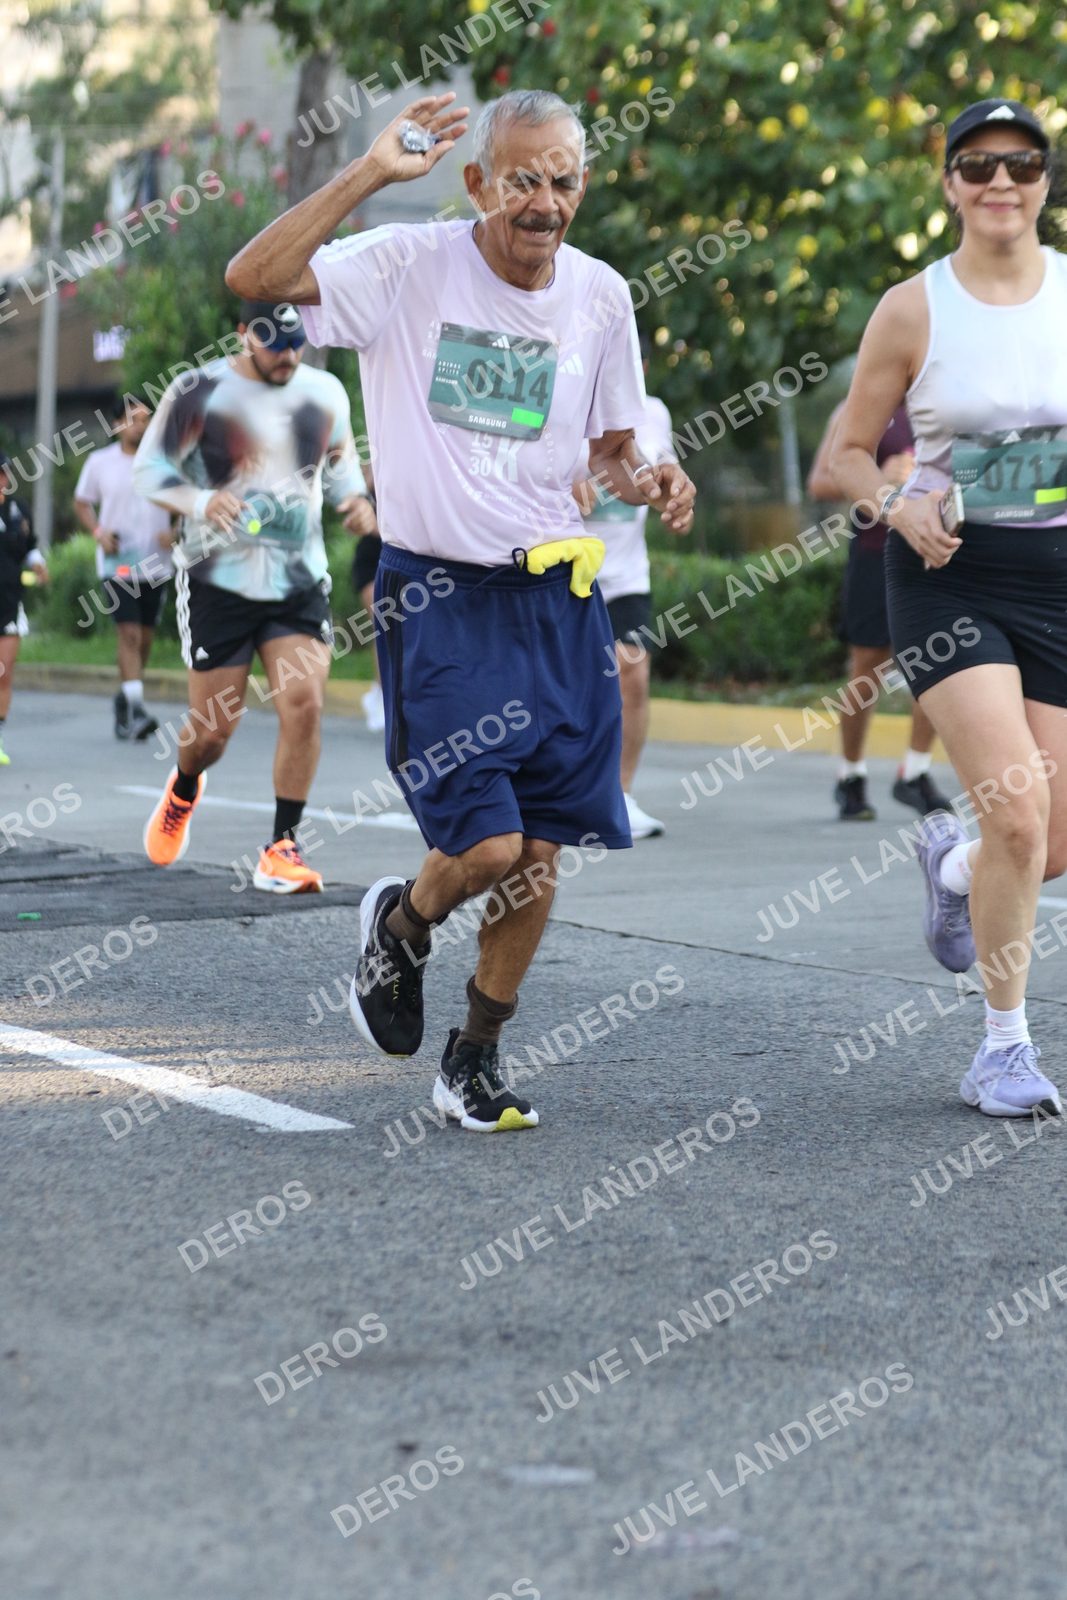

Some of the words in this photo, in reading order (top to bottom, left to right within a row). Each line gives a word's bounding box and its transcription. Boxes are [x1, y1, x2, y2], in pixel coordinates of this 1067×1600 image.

[467, 358, 549, 407] 0114
[468, 414, 507, 428] SAMSUNG
[468, 456, 492, 477] 30
[994, 509, 1035, 519] SAMSUNG
